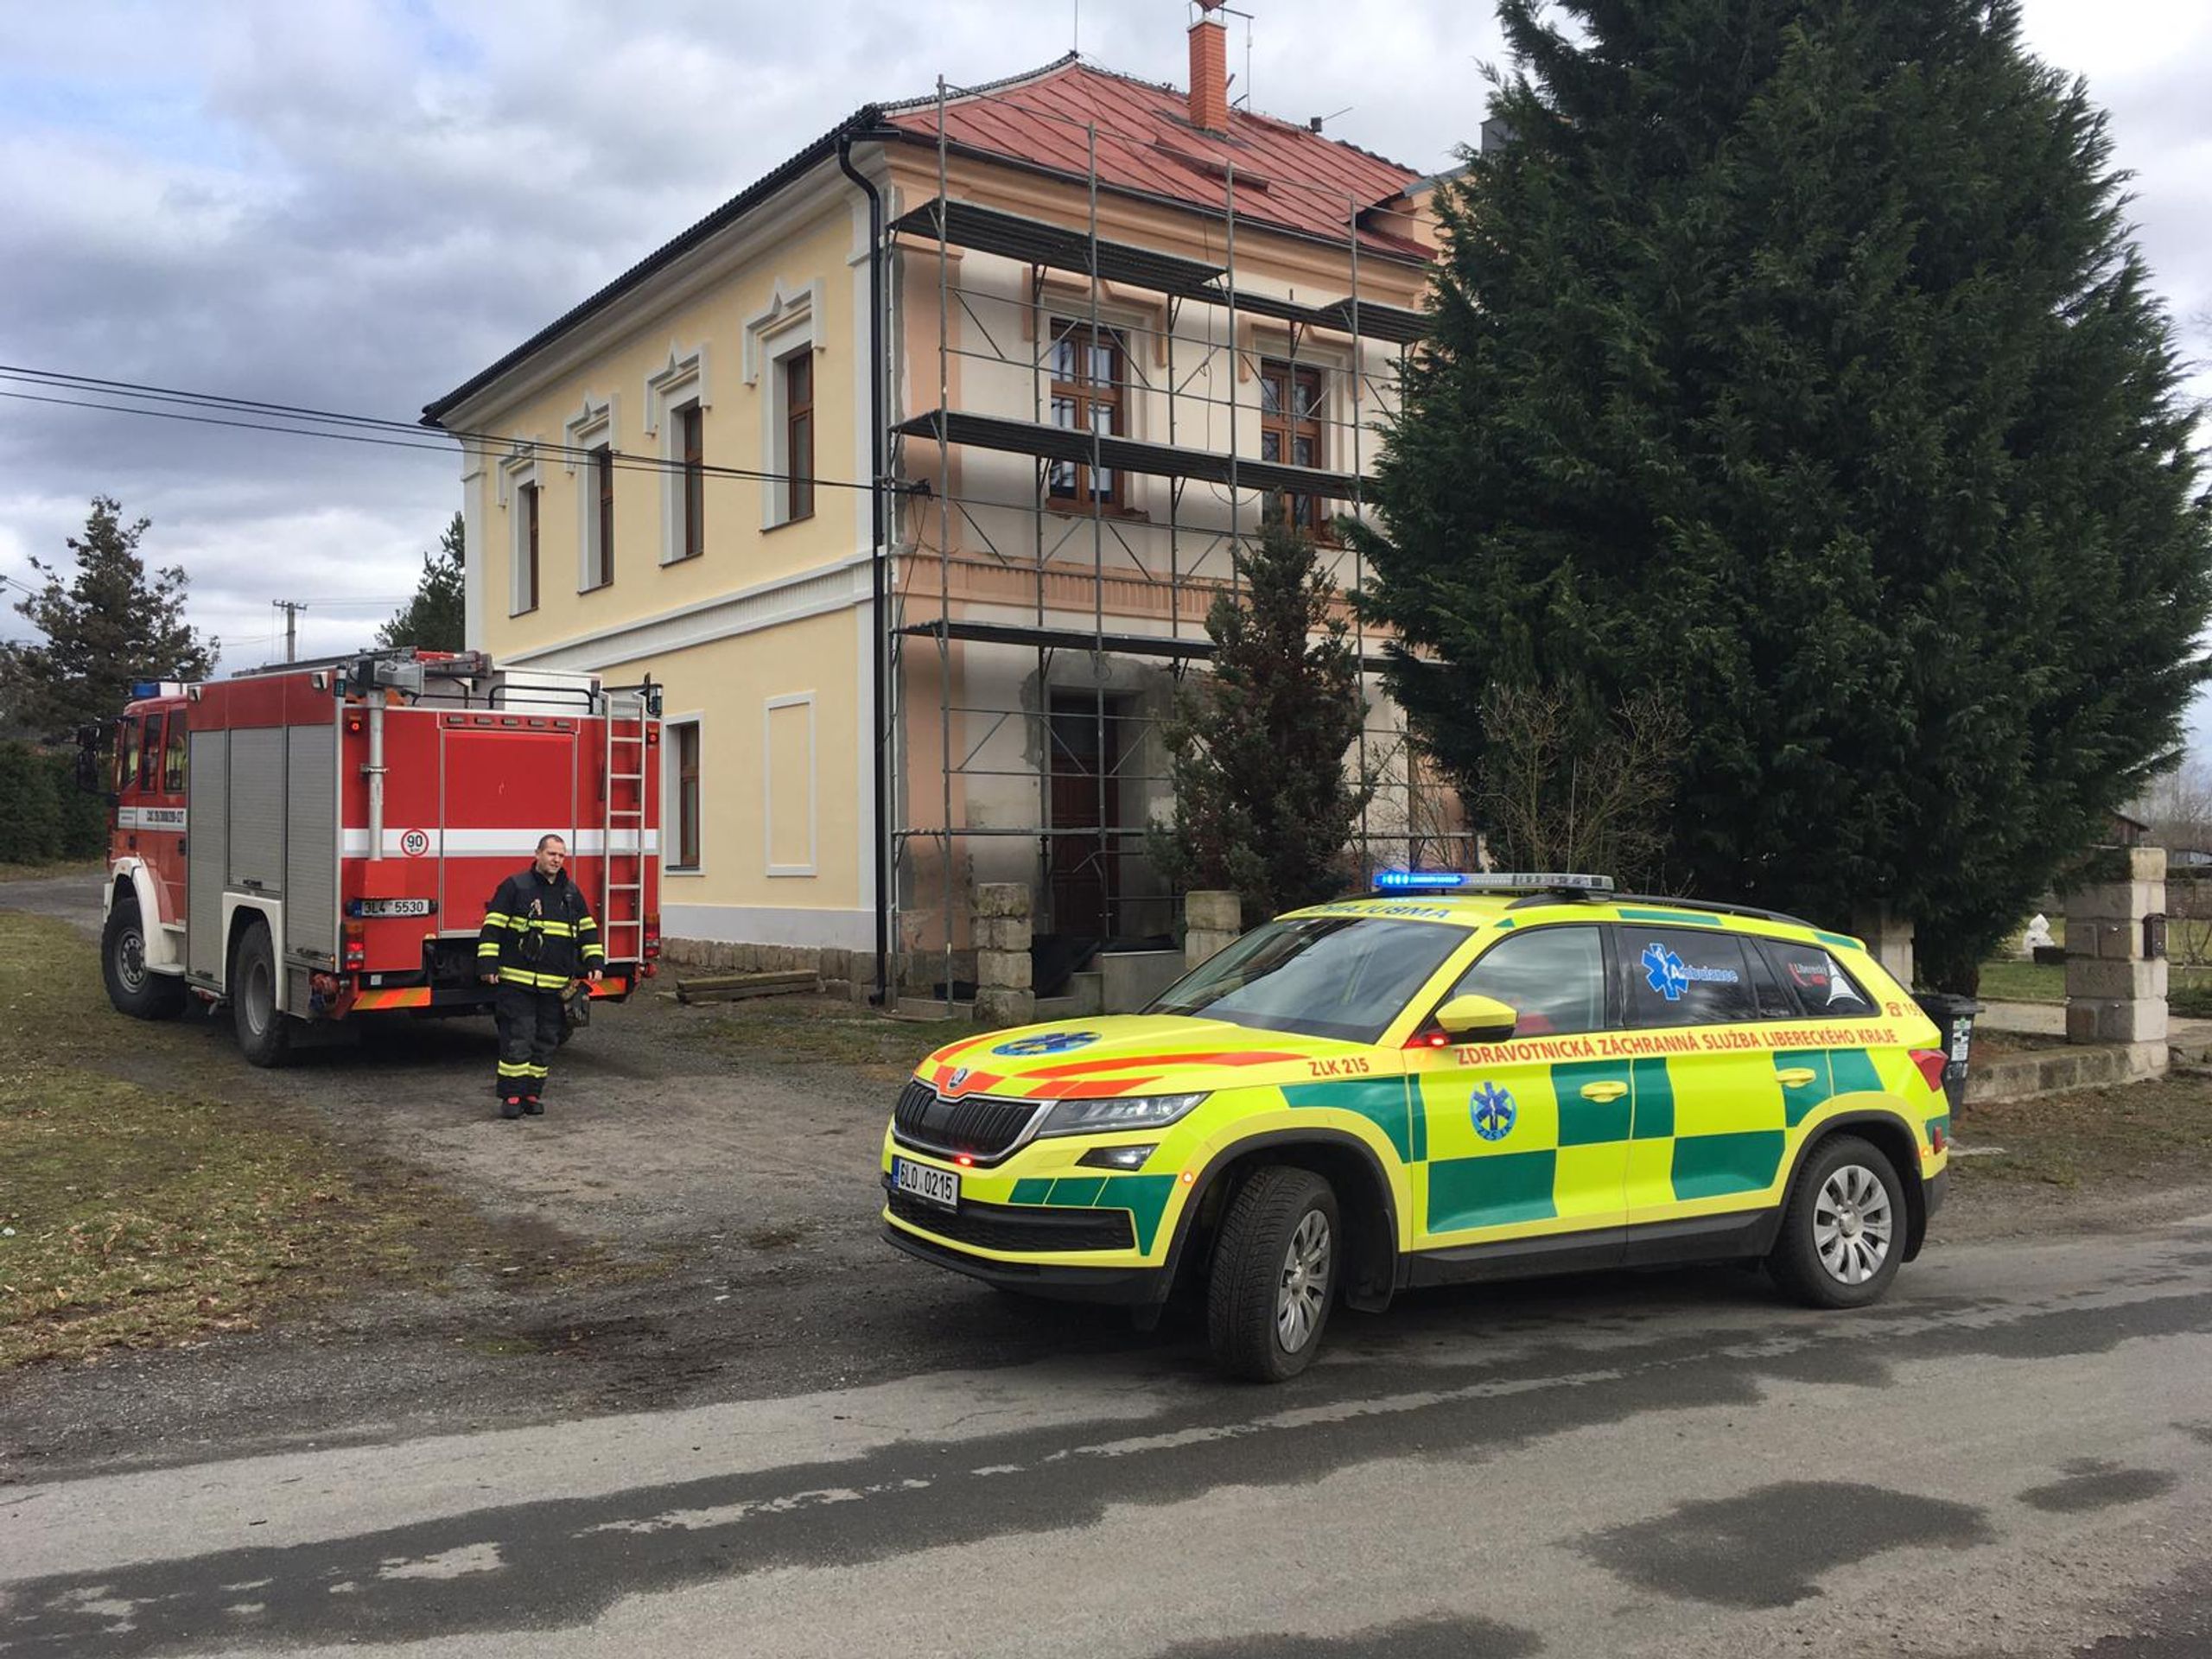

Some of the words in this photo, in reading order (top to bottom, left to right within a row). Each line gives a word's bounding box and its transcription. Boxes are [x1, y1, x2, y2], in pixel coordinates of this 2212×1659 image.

[407, 835, 423, 847] 90
[365, 902, 385, 913] 3L4
[395, 901, 424, 913] 5530
[1455, 1037, 1596, 1065] ZDRAVOTNICKÁ
[1598, 1032, 1700, 1055] ZÁCHRANNÁ
[1701, 1031, 1761, 1051] SLUŽBA
[1762, 1027, 1856, 1047] LIBERECKÉHO
[1858, 1029, 1899, 1044] KRAJE
[1308, 1059, 1341, 1076] ZLK
[1342, 1058, 1370, 1073] 215
[899, 1163, 918, 1189] 6L0
[925, 1171, 952, 1200] 0215
